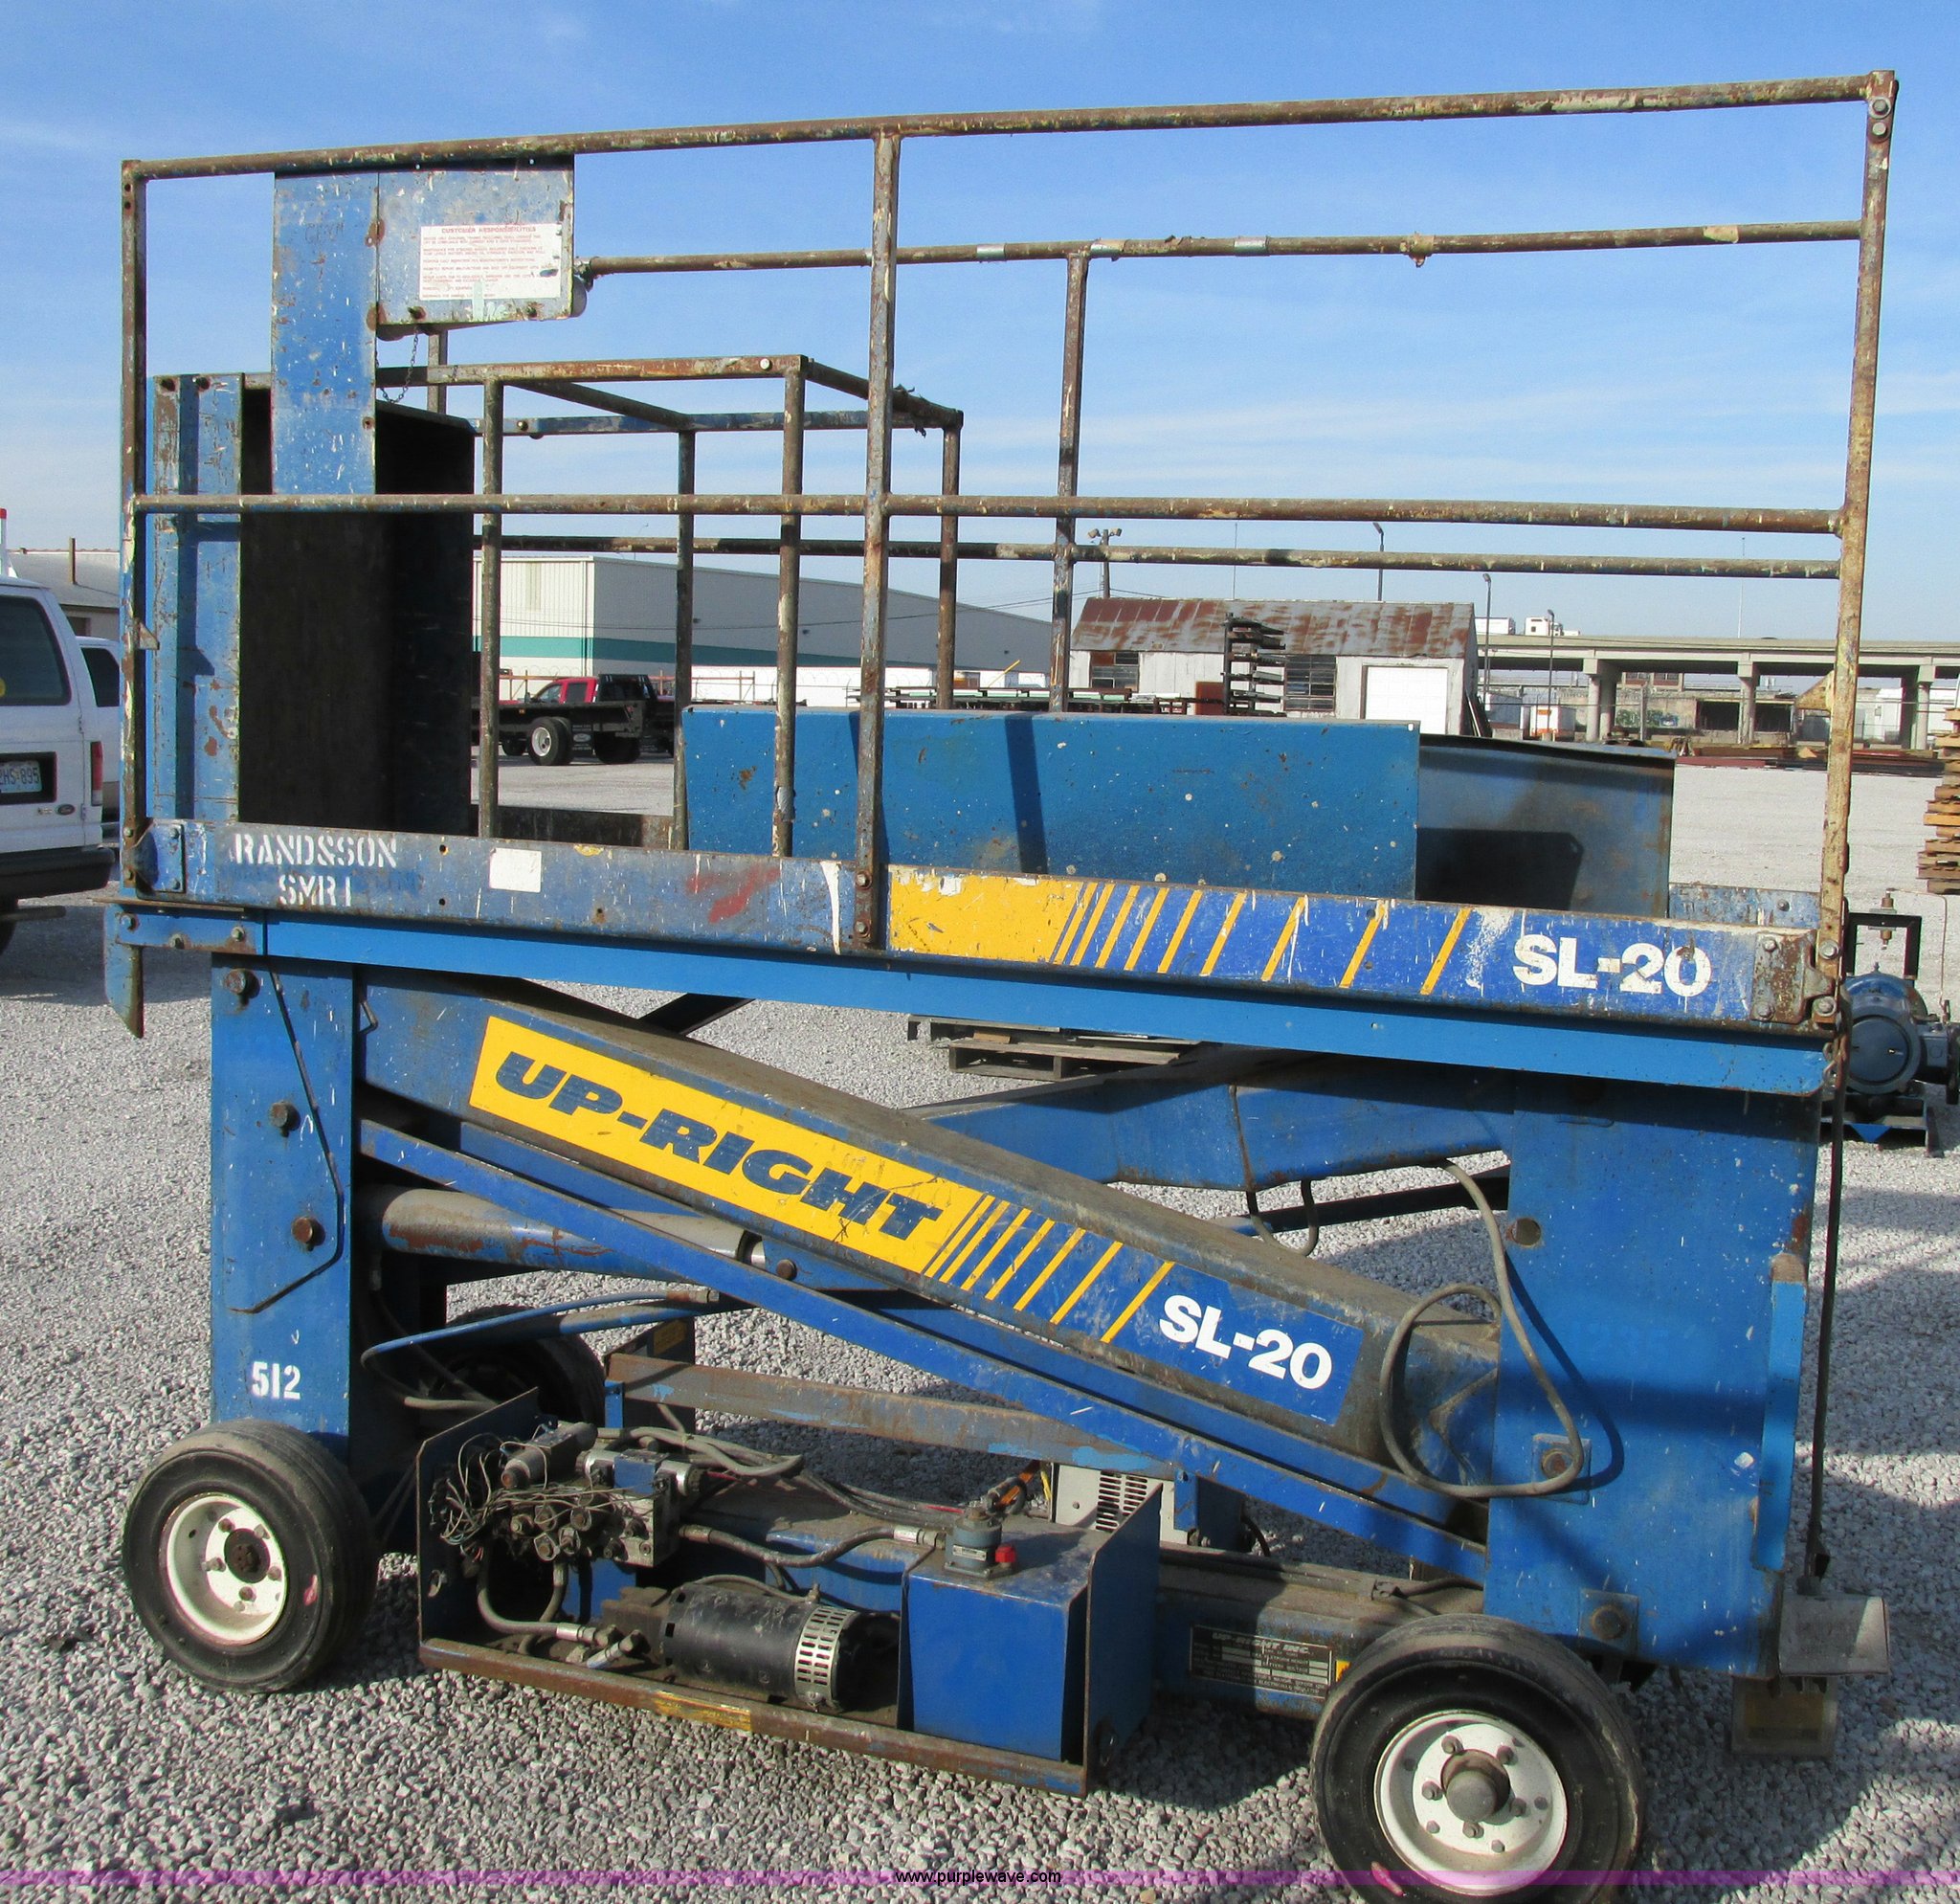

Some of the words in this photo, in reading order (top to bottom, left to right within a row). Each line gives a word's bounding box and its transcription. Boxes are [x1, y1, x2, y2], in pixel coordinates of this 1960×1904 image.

[1512, 932, 1712, 997] SL-20
[496, 1050, 945, 1242] UP-RIGHT
[252, 1360, 301, 1400] 512
[1159, 1294, 1333, 1390] SL-20
